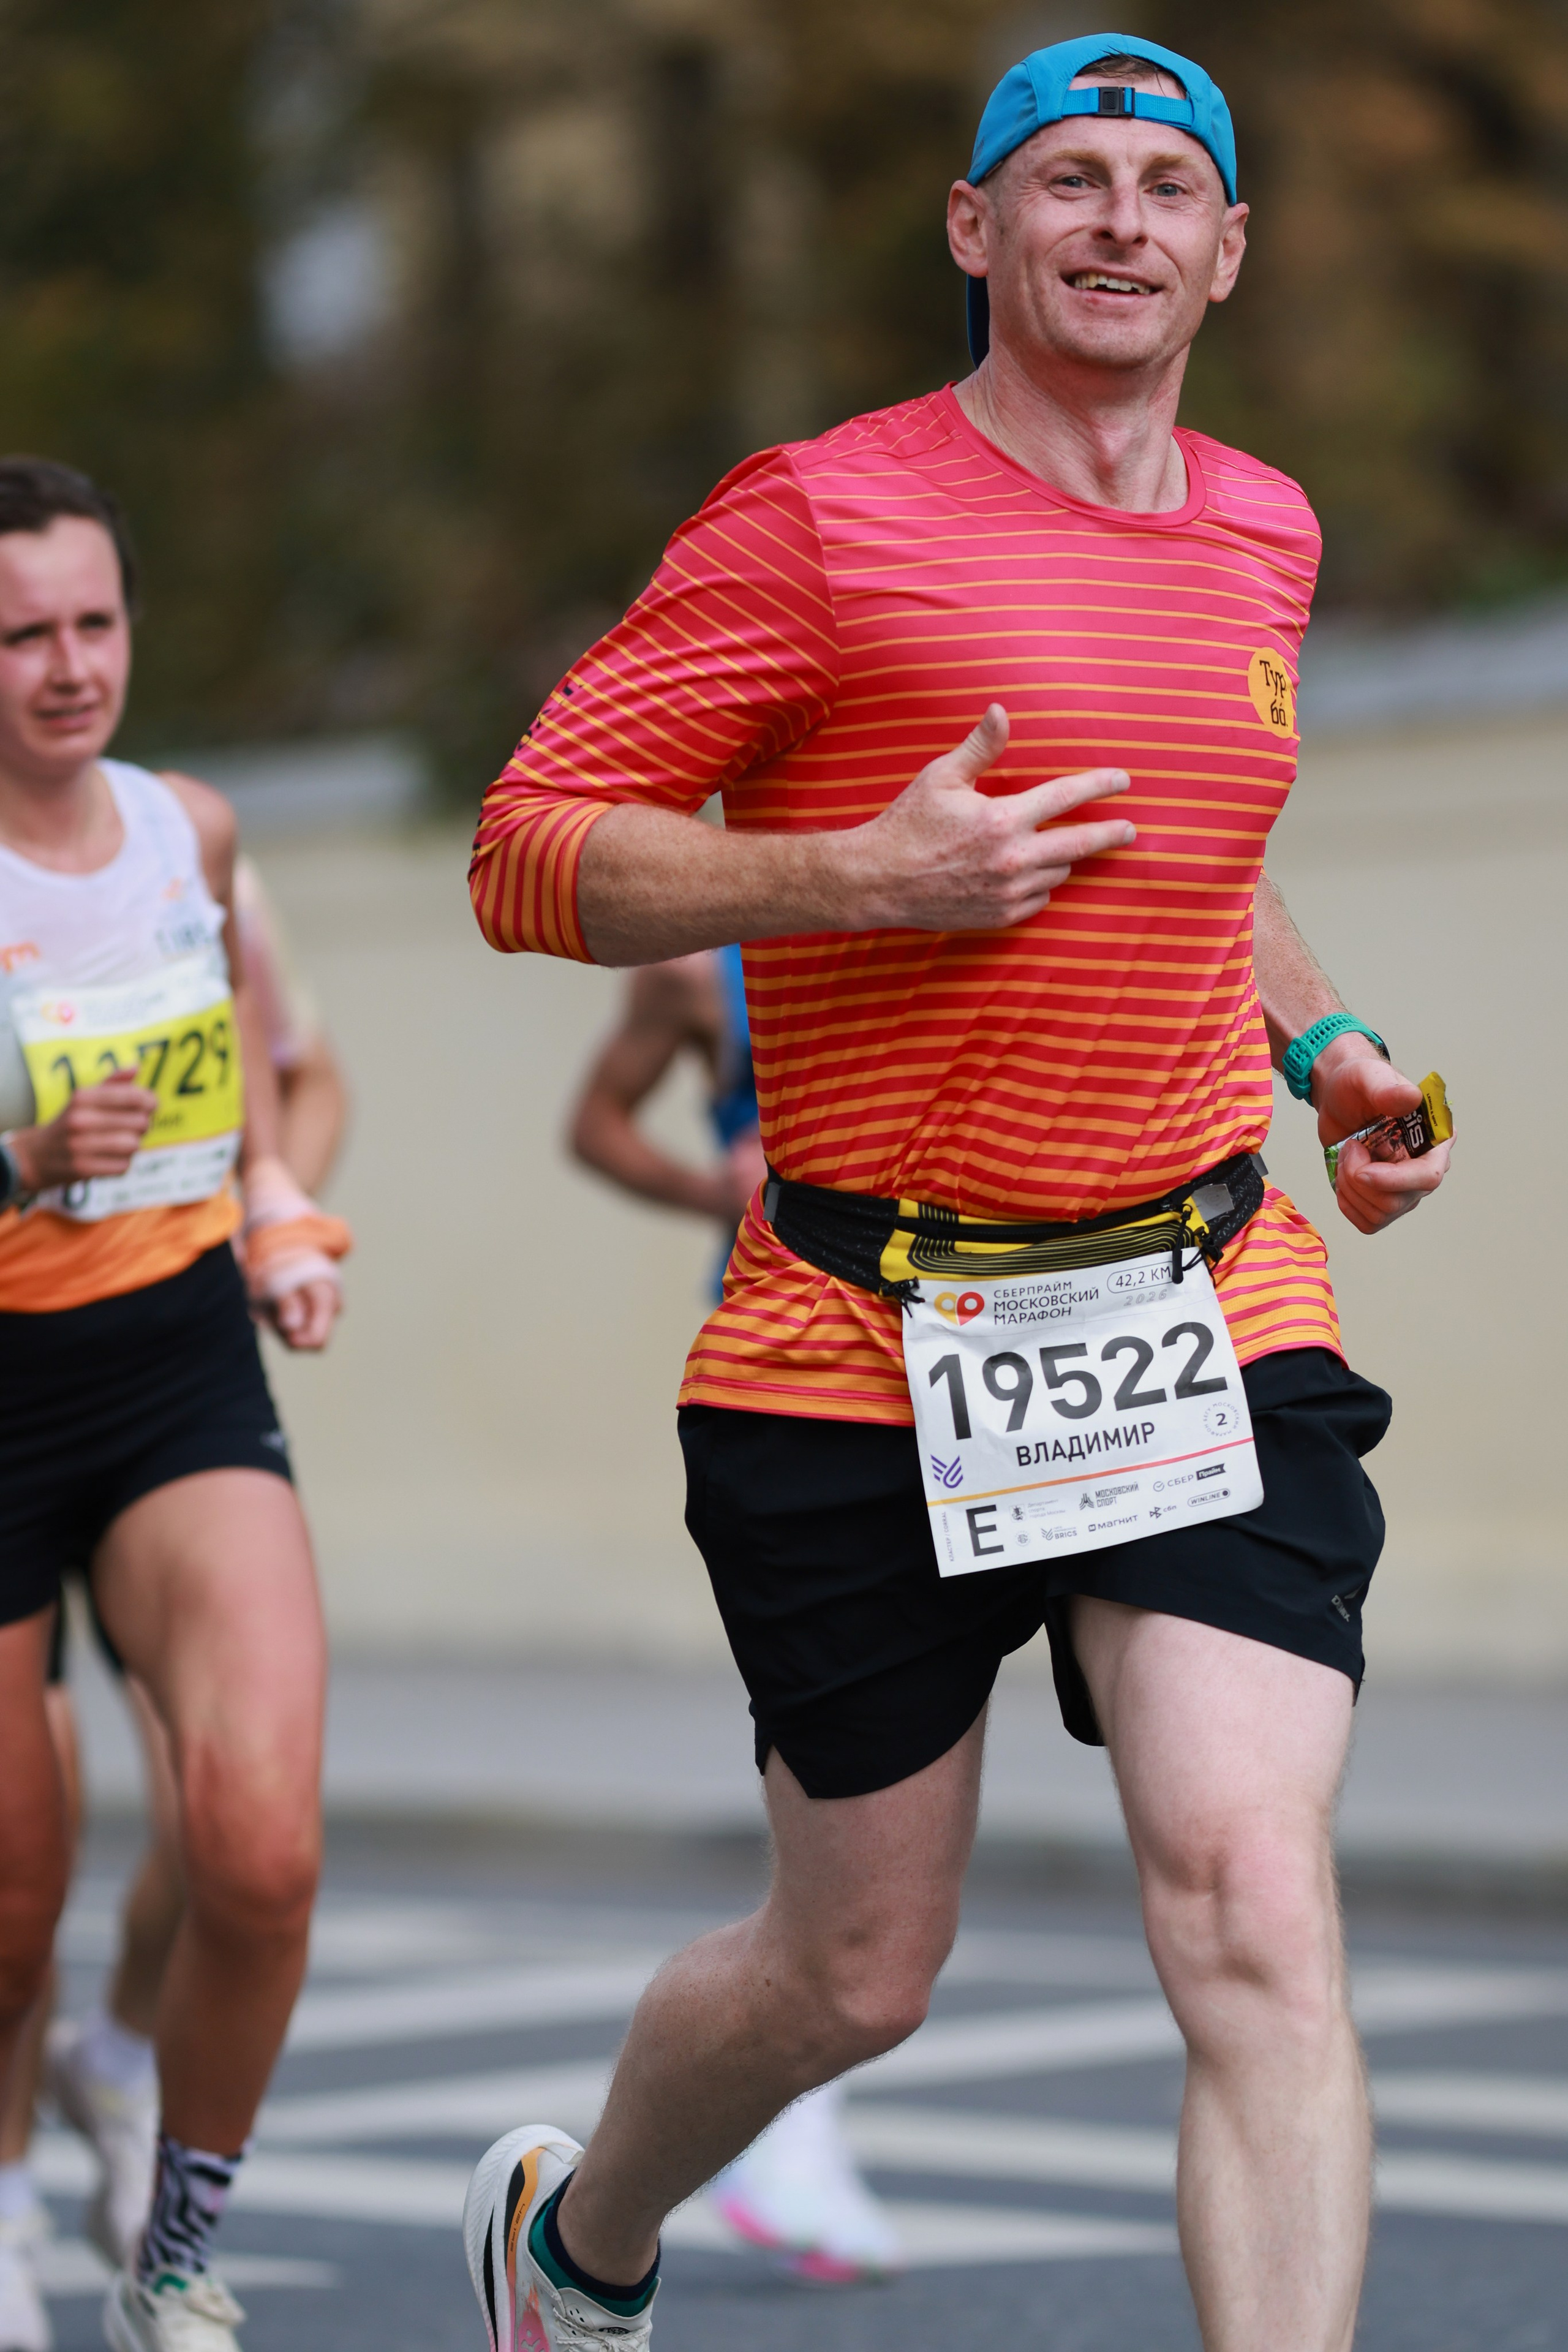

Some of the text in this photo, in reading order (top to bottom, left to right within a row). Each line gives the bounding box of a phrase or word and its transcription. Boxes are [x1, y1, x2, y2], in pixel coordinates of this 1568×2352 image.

[1115, 1272, 1145, 1287] 42,2
[993, 1281, 1072, 1298] СБЕРПРАЙМ
[993, 1287, 1099, 1312] МОСКОВСКИЙ
[1123, 1289, 1167, 1306] 2026
[994, 1306, 1072, 1325] МАРАФОН
[927, 1322, 1228, 1441] 19522
[1216, 1412, 1227, 1426] 2
[1016, 1422, 1155, 1466] ВЛАДИМИР
[1167, 1474, 1194, 1487] СБЕР
[1095, 1482, 1139, 1498] МОСКОВСКИЙ
[1191, 1491, 1221, 1504] WINLINE
[1096, 1496, 1117, 1507] СПОРТ
[1098, 1515, 1138, 1529] магнит
[1054, 1530, 1077, 1539] BRICS
